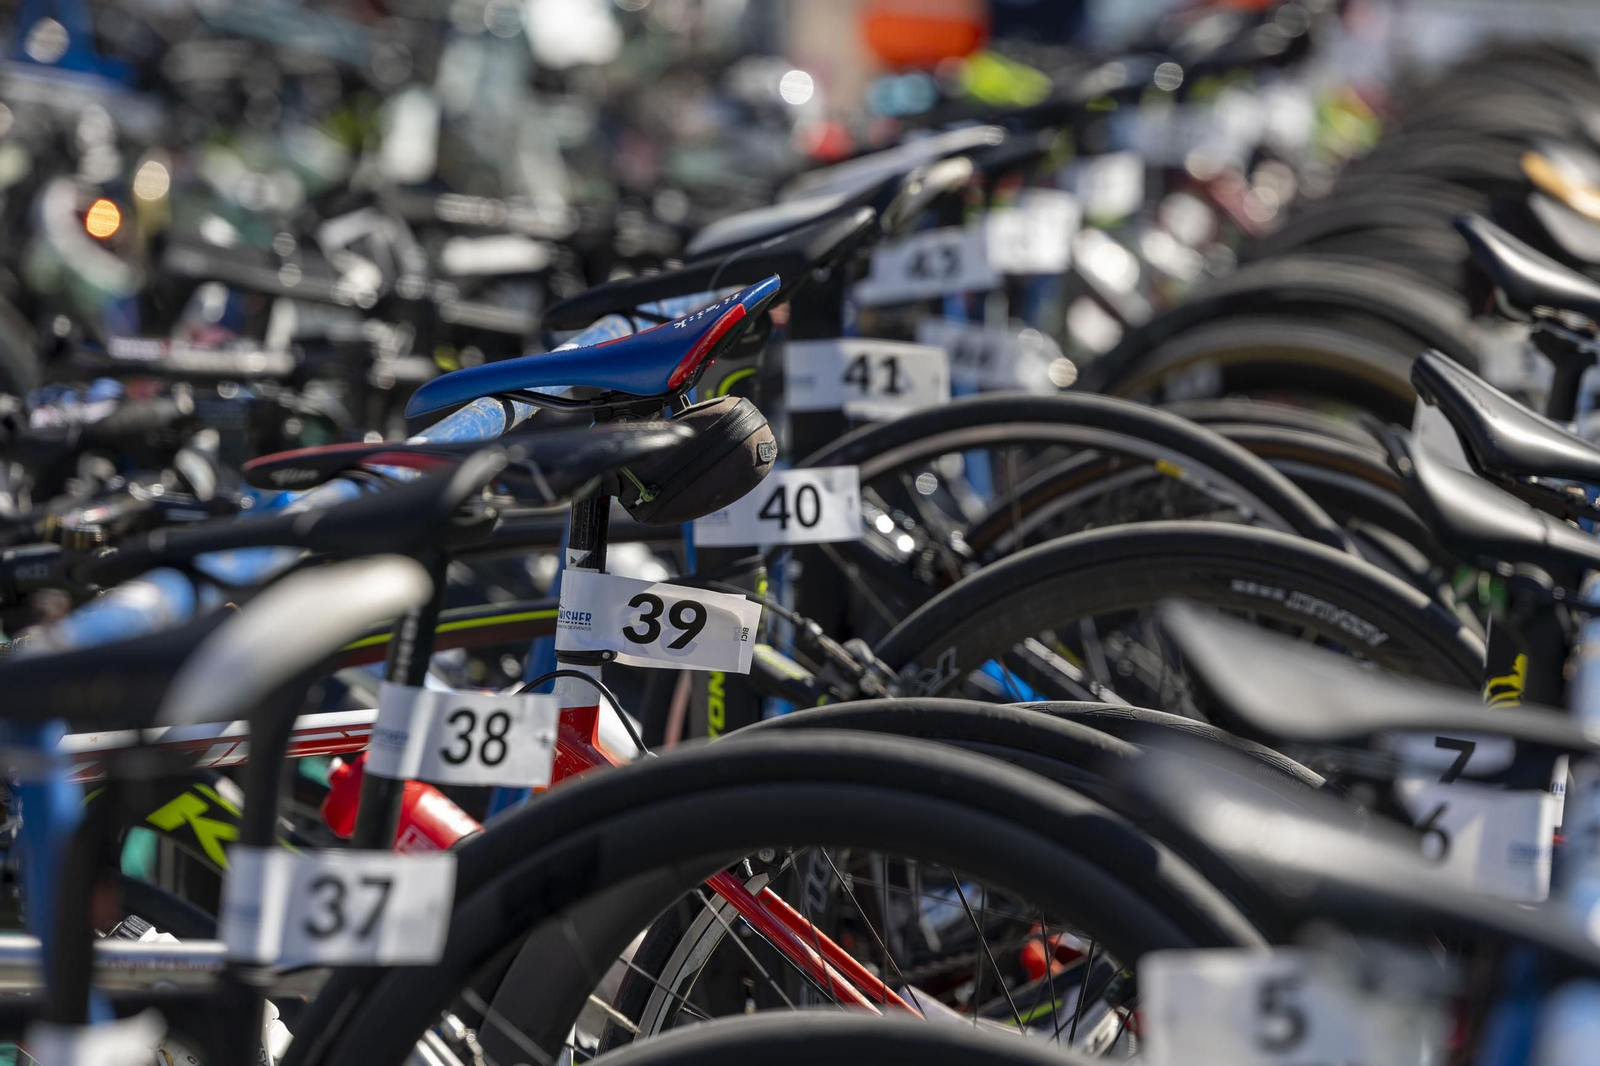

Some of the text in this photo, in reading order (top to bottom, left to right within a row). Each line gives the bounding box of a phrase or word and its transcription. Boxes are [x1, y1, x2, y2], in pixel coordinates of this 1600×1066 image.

[842, 353, 903, 395] 41
[758, 483, 822, 530] 40
[622, 593, 707, 649] 39
[740, 627, 750, 642] BICI
[440, 709, 511, 767] 38
[1434, 736, 1476, 784] 7
[305, 874, 394, 940] 37
[1254, 974, 1308, 1054] 5
